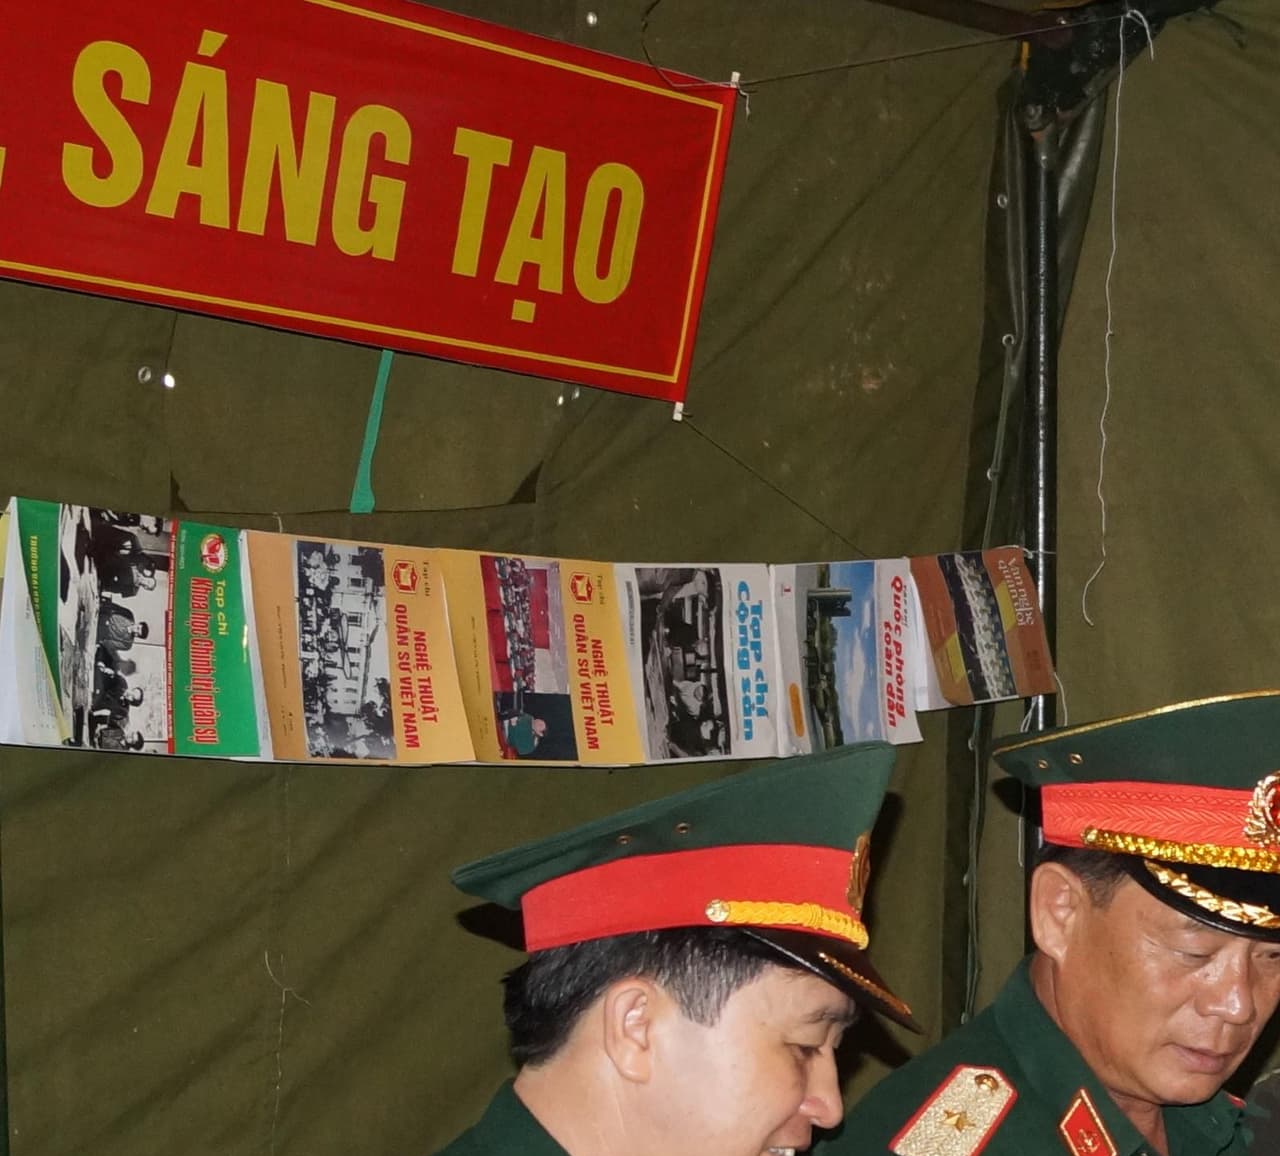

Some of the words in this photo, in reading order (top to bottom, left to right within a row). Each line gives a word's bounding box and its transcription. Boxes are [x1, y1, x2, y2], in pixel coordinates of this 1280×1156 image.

[61, 28, 412, 261] SÁNG
[451, 127, 645, 324] TẠO
[191, 577, 214, 609] Khoa
[891, 575, 904, 637] Quốc
[185, 612, 212, 635] học
[394, 604, 412, 646] QUÂN
[573, 614, 589, 653] QUÂN
[735, 581, 751, 670] Cộng
[749, 600, 763, 663] Tạp
[397, 651, 414, 673] SỰ
[412, 631, 432, 672] NGHỆ
[577, 658, 591, 679] SỰ
[589, 639, 608, 677] NGHỆ
[884, 621, 894, 675] toàn
[399, 677, 417, 708] VIỆT
[417, 676, 439, 723] THUẬT
[580, 683, 594, 711] VIỆT
[755, 668, 769, 718] chí
[893, 640, 906, 718] phòng
[596, 682, 614, 726] THUẬT
[741, 677, 756, 741] sản
[886, 682, 897, 727] dân
[403, 712, 420, 749] NAM
[584, 716, 599, 750] NAM
